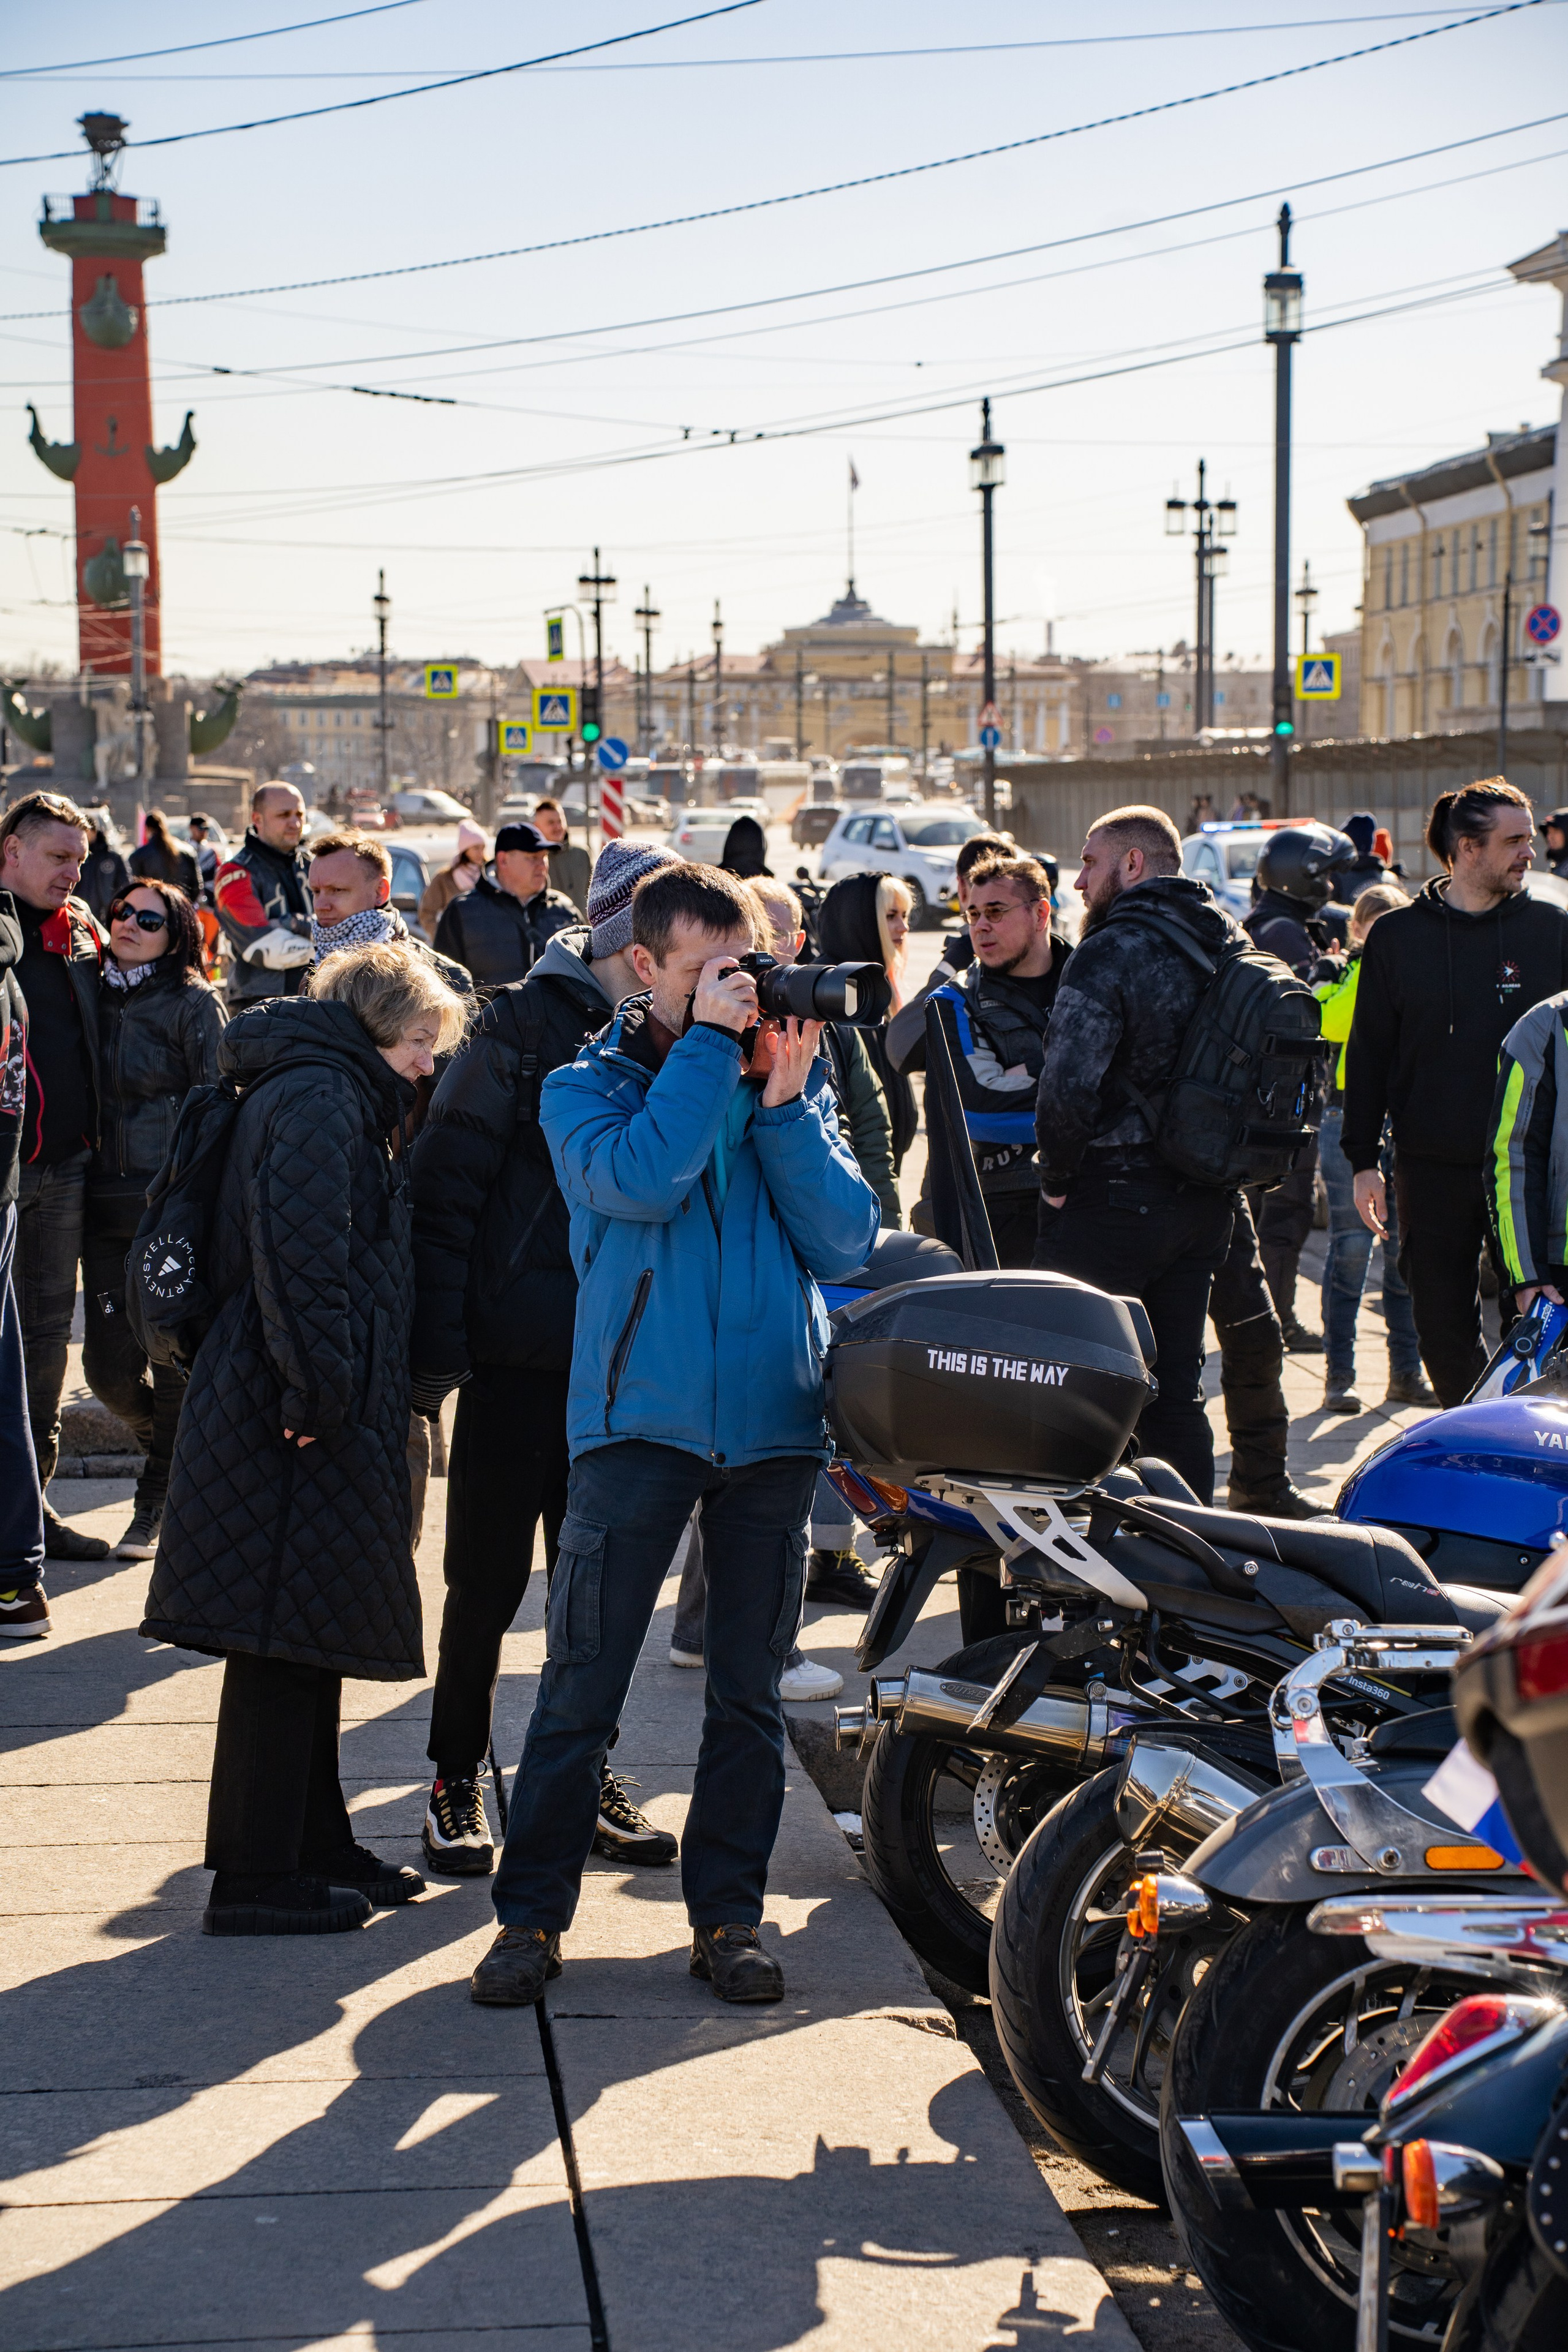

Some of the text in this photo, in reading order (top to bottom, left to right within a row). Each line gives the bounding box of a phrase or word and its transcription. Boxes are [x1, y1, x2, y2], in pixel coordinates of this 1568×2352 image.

[927, 1349, 1069, 1386] THIS IS THE WAY
[1533, 1430, 1568, 1450] YA
[1349, 1676, 1390, 1700] Insta360
